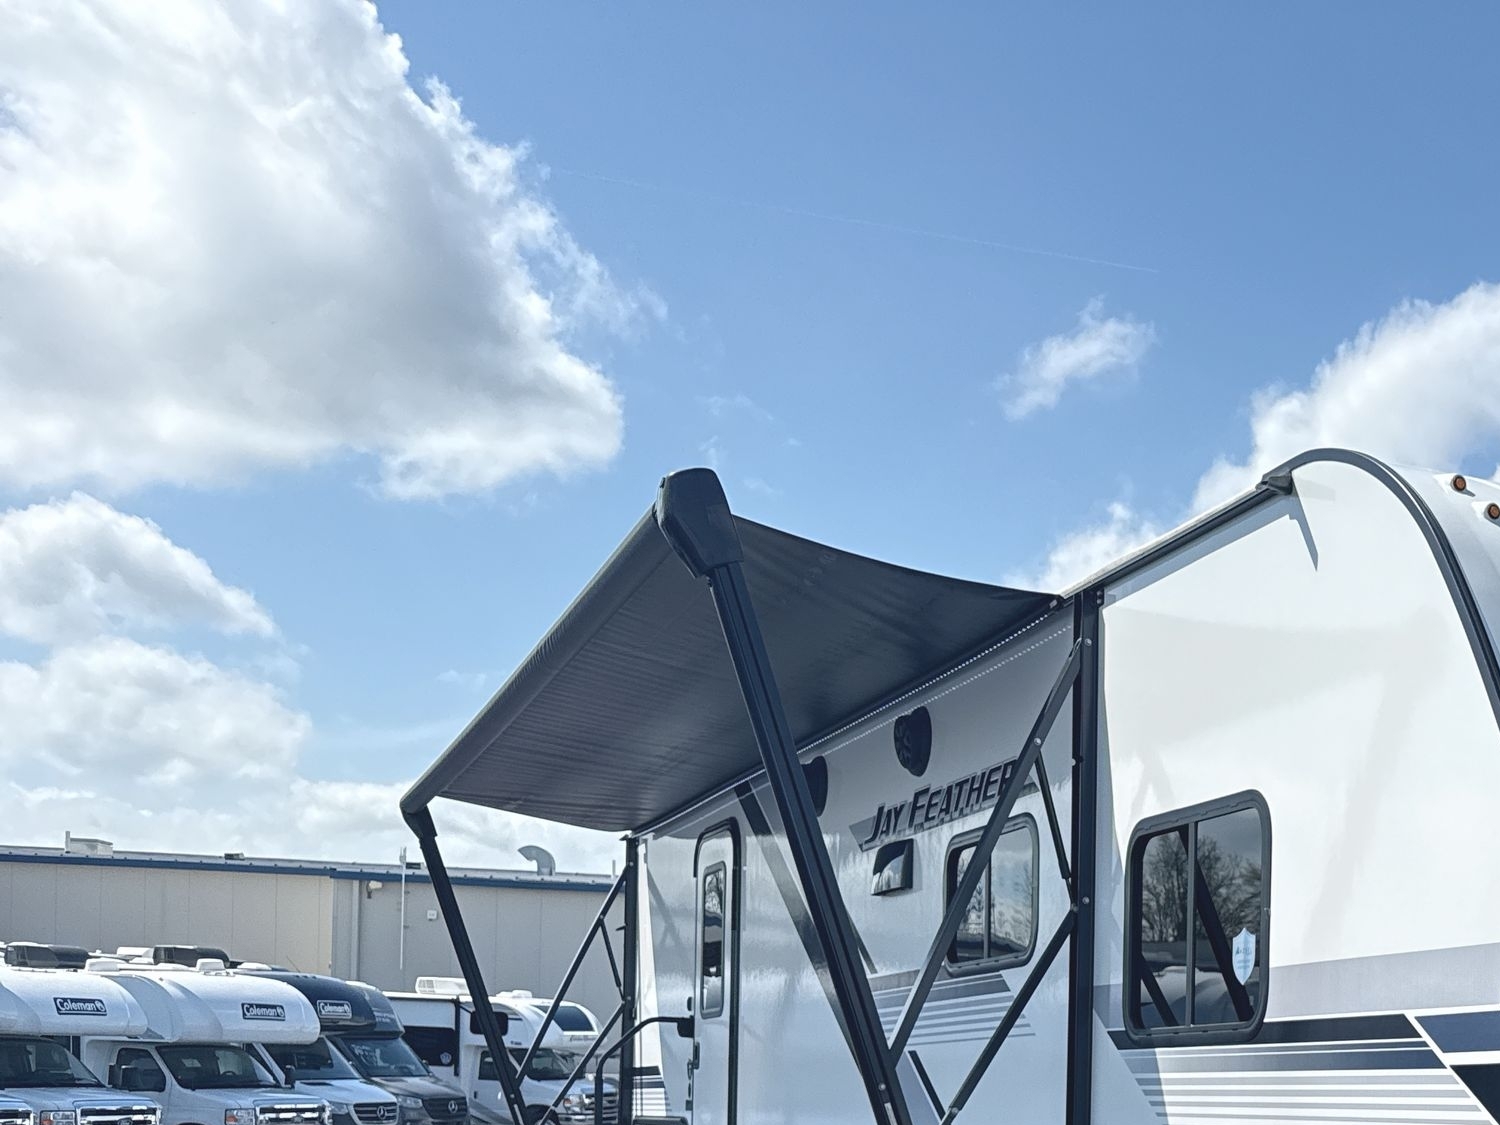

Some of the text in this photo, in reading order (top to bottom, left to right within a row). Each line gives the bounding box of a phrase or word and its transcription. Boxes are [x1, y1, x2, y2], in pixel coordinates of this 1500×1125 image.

[864, 803, 906, 845] JAY
[56, 998, 97, 1012] Coleman
[243, 1003, 278, 1017] Coleman
[319, 1001, 346, 1014] Coleman
